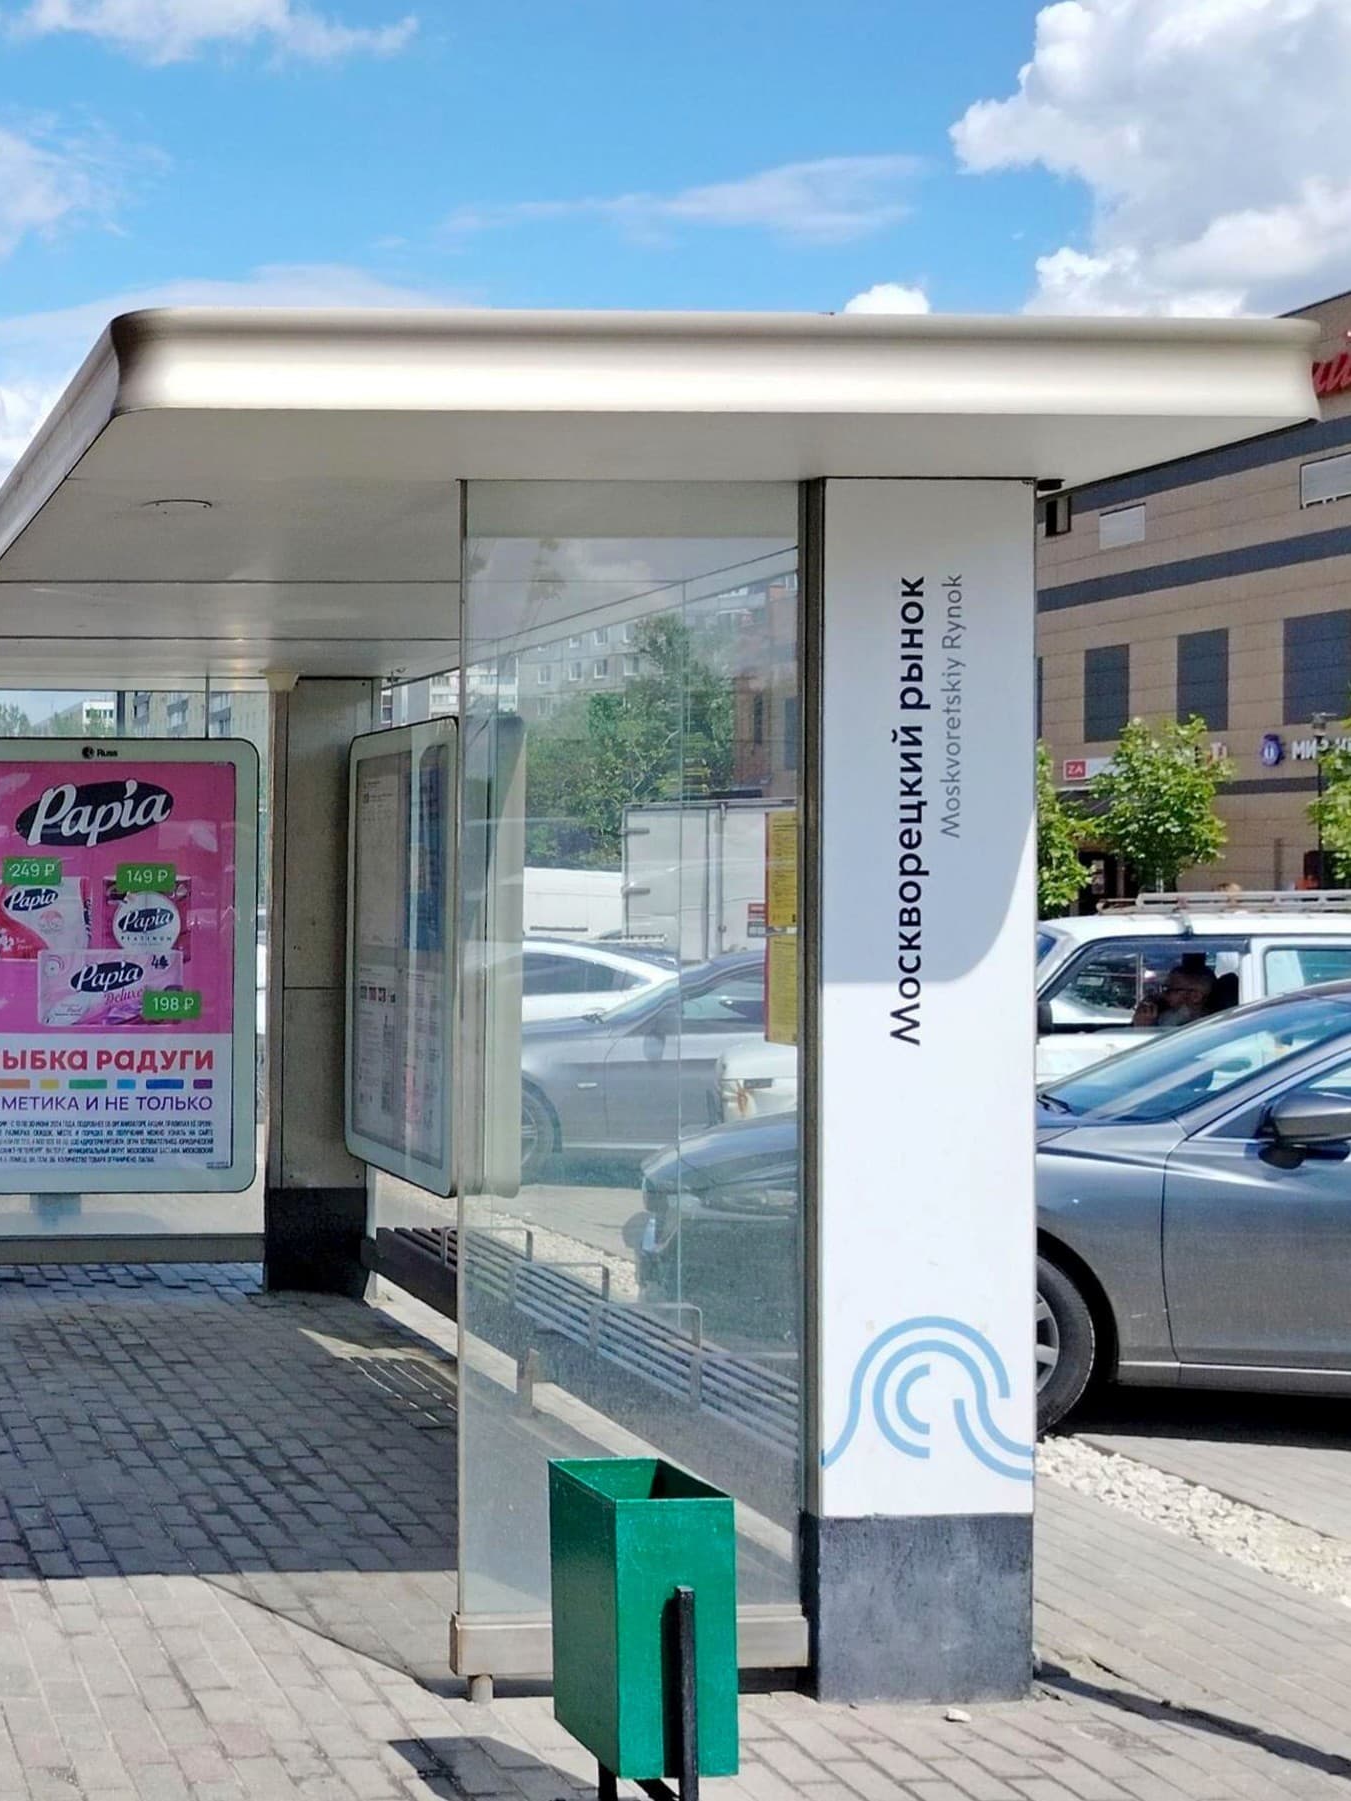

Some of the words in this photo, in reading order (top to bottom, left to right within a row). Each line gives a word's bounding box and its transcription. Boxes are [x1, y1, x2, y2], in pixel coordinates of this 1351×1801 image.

[941, 574, 967, 649] Rynok
[899, 576, 931, 710] рынок
[940, 656, 966, 839] Moskvoretskiy
[26, 779, 171, 848] Papia
[11, 863, 40, 878] 249
[126, 869, 152, 883] 149
[889, 724, 930, 1046] Москворецкий
[6, 888, 59, 911] Papia
[122, 908, 174, 933] Papia
[75, 960, 143, 992] Papia
[153, 997, 178, 1011] 198
[85, 1096, 99, 1111] И
[105, 1096, 129, 1111] НЕ
[136, 1096, 213, 1111] ТОЛЬКО
